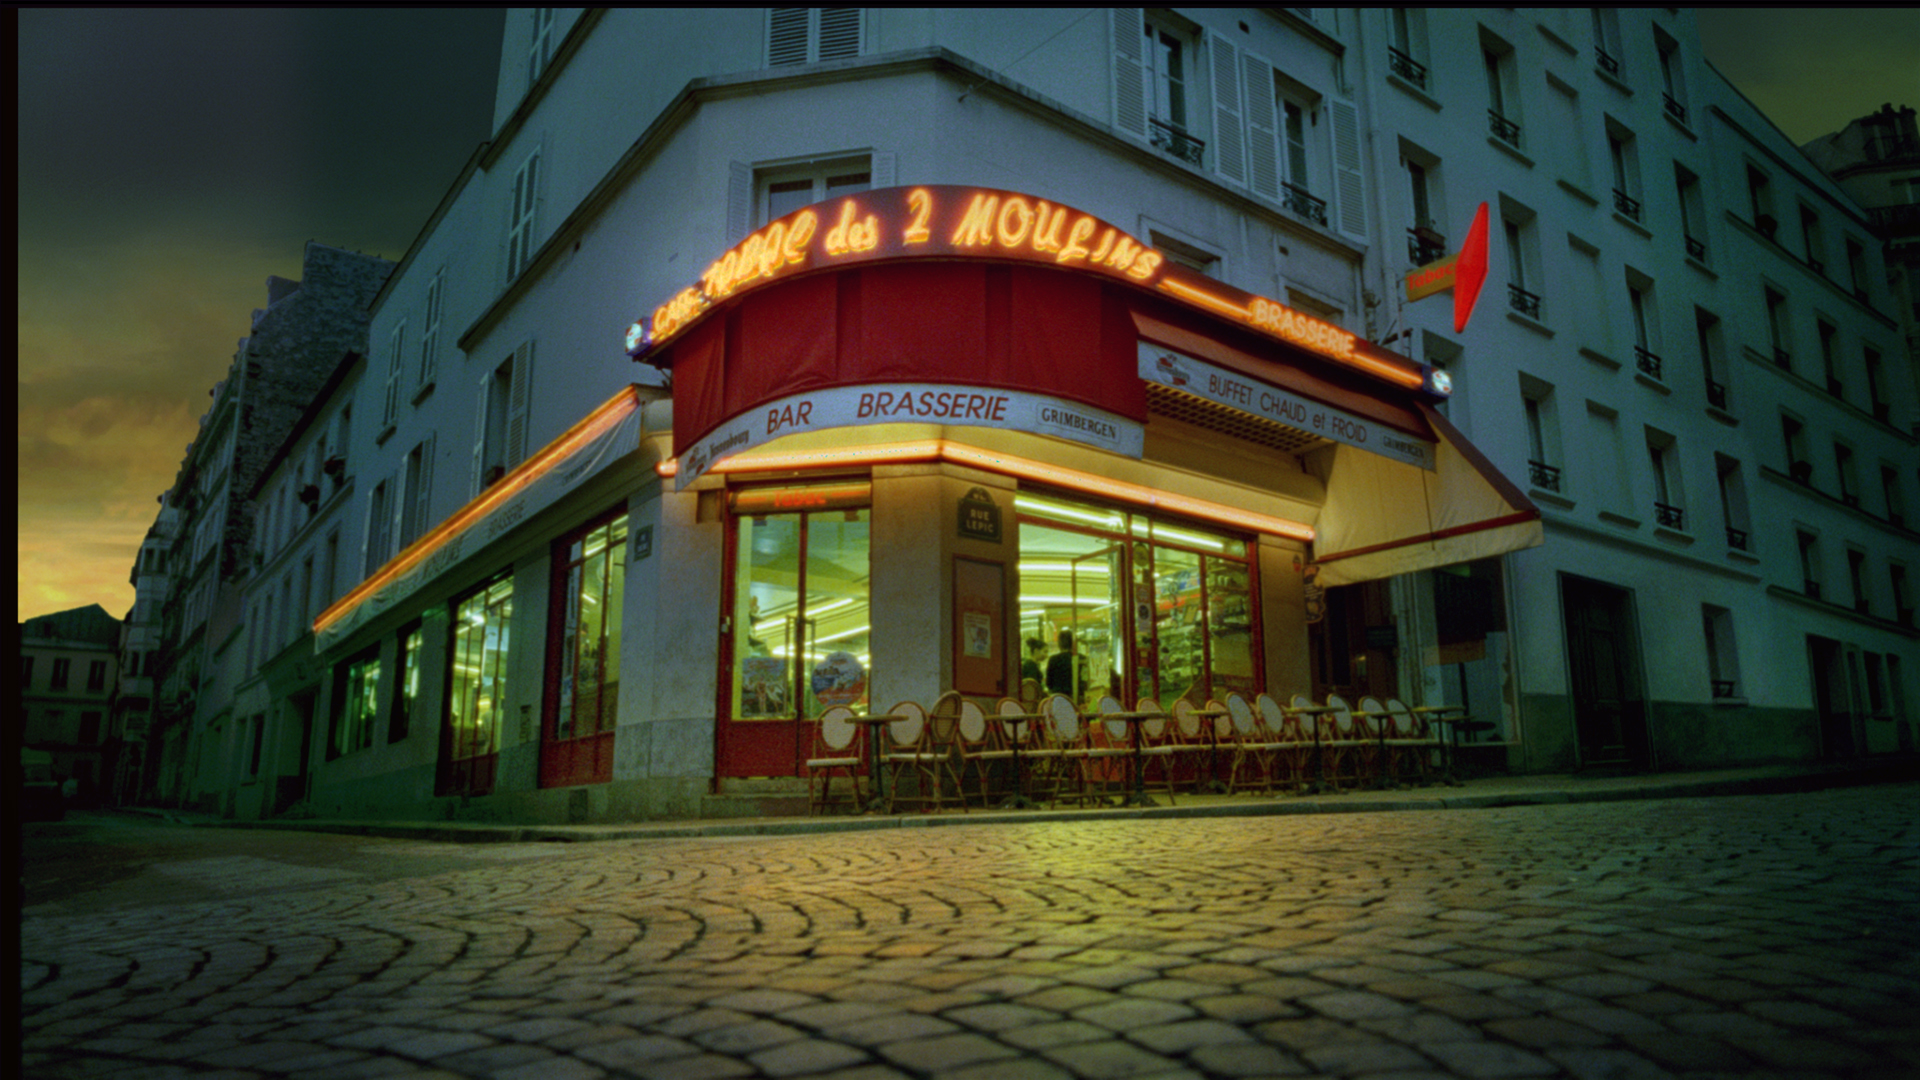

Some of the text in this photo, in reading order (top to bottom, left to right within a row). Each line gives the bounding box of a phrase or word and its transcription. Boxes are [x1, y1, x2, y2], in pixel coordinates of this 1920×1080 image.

[825, 199, 879, 255] des
[903, 188, 932, 245] 2
[951, 193, 1163, 279] MOULINS
[1406, 263, 1455, 291] Tabac
[1250, 298, 1355, 358] BRASSERIE
[767, 391, 1010, 436] BAR BRASSERIE
[1041, 407, 1117, 440] GRIMBERGEN
[1208, 373, 1368, 444] BUFFET CHAUD et FROID
[774, 488, 827, 508] Tabac
[970, 508, 990, 521] RUE
[965, 520, 994, 533] LEPIC
